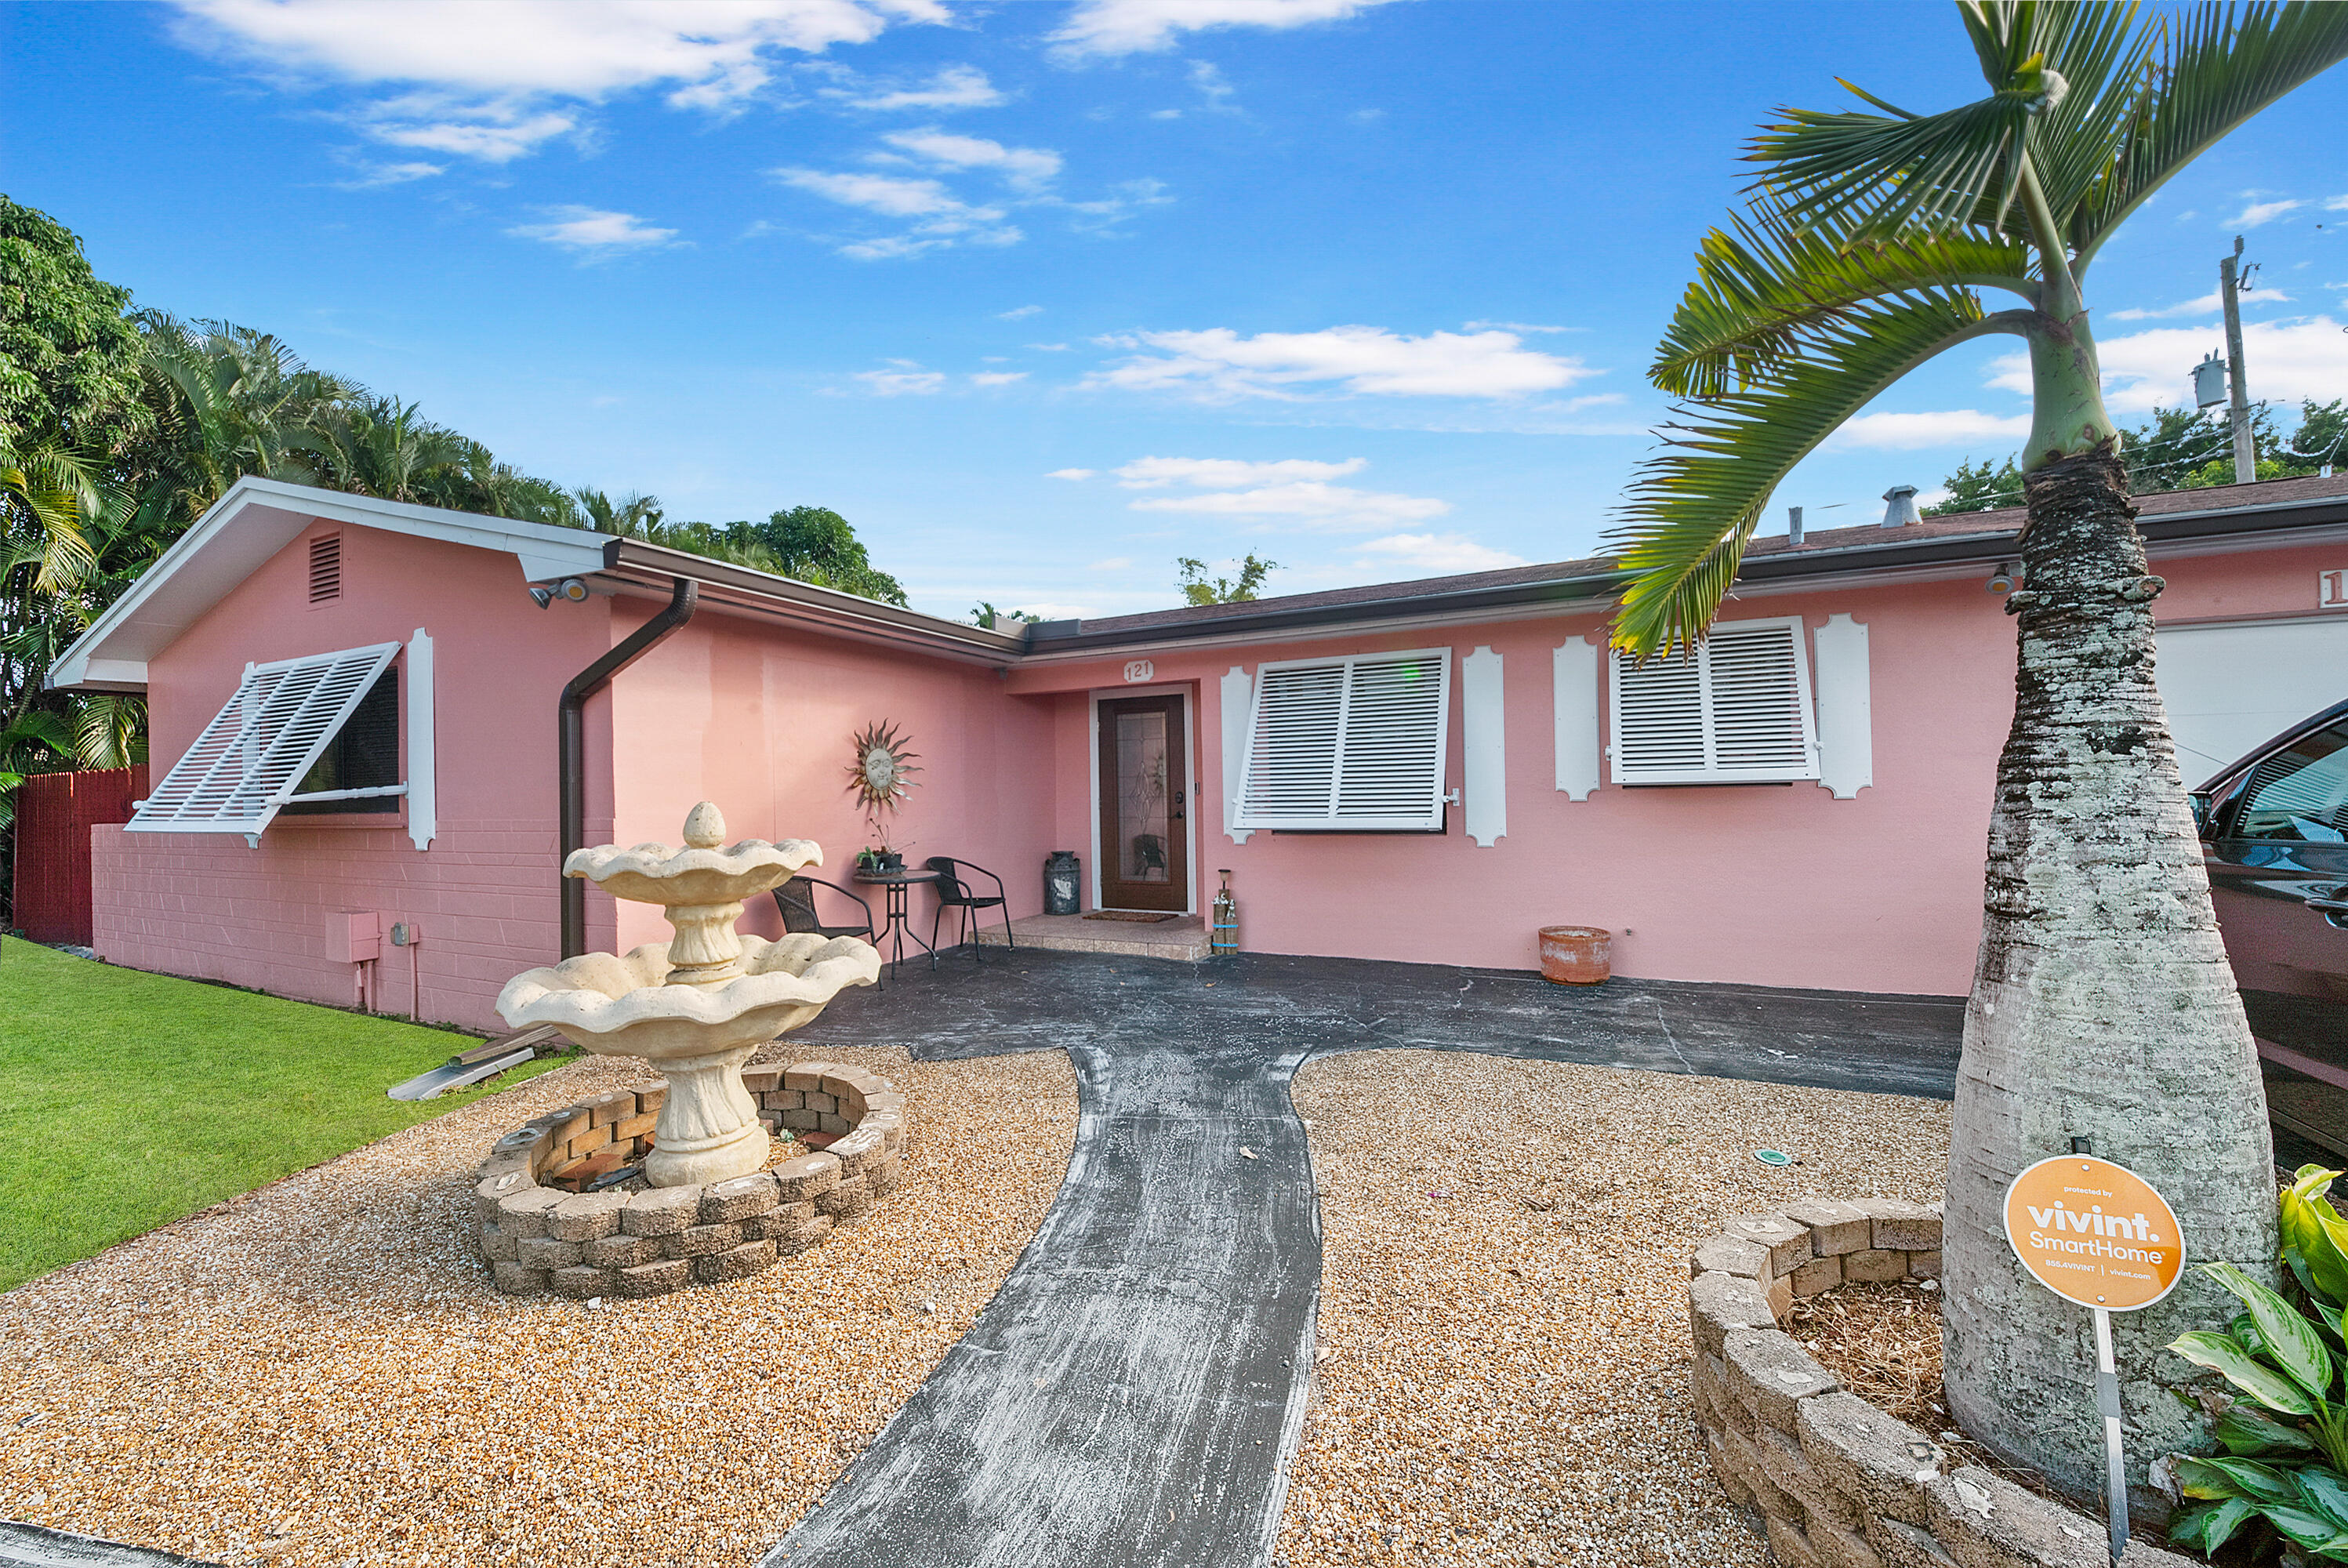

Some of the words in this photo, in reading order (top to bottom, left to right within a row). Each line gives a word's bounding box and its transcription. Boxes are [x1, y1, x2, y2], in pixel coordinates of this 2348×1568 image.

[2324, 571, 2348, 604] 1
[1127, 661, 1149, 681] 121
[2063, 1186, 2101, 1196] protected
[2102, 1189, 2113, 1198] by
[2027, 1200, 2160, 1243] vivint.
[2045, 1259, 2096, 1272] 855.4VIVINT
[2109, 1269, 2151, 1280] vivint.com
